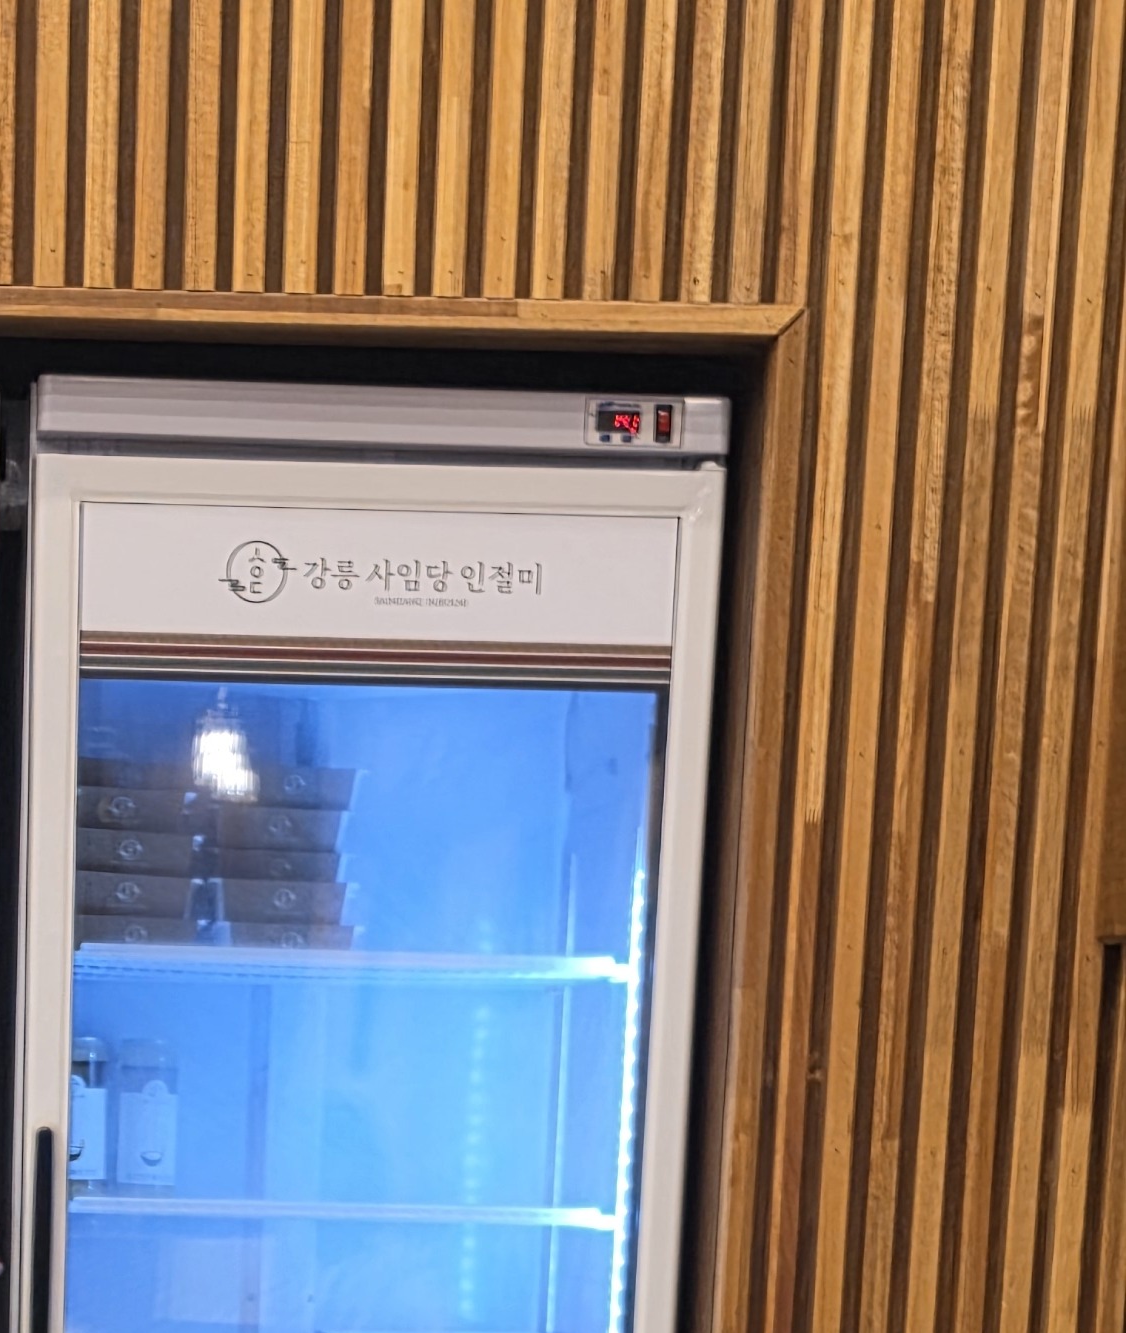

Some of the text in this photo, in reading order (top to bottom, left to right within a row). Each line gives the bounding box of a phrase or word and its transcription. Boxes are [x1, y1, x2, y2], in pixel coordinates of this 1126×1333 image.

[303, 558, 543, 595] 강릉 사임당 인절미
